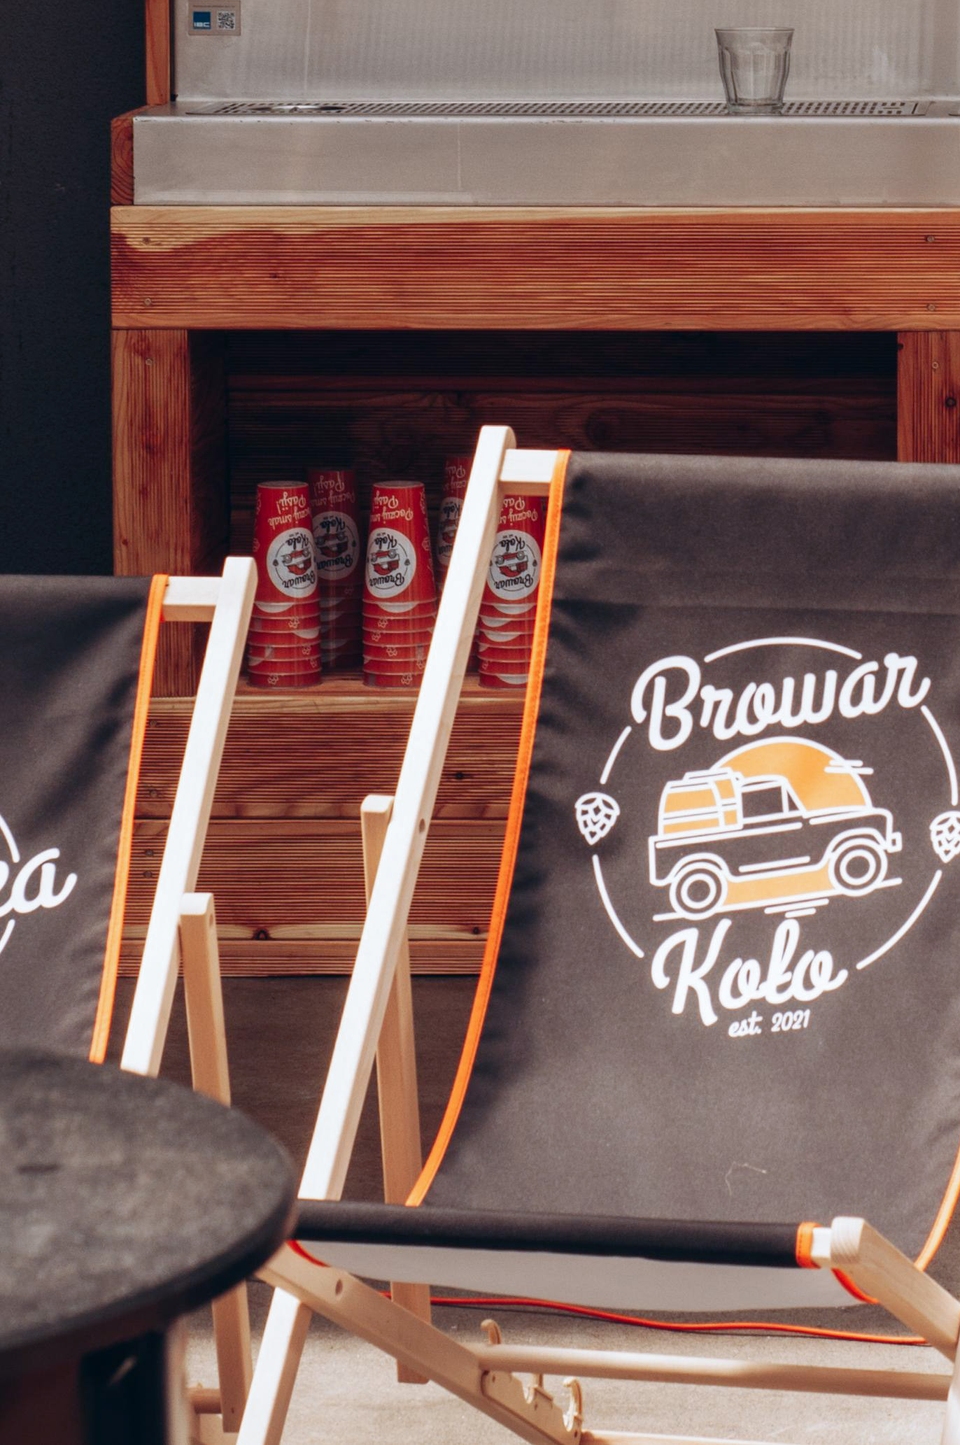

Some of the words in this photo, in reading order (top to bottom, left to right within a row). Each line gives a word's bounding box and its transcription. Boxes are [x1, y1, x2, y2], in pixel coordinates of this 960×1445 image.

[282, 571, 316, 588] Browar
[369, 573, 405, 587] Browar
[493, 574, 534, 589] Browar
[631, 652, 931, 751] Browar
[651, 918, 848, 1026] Koło
[728, 1016, 762, 1037] est.
[771, 1009, 811, 1032] 2021
